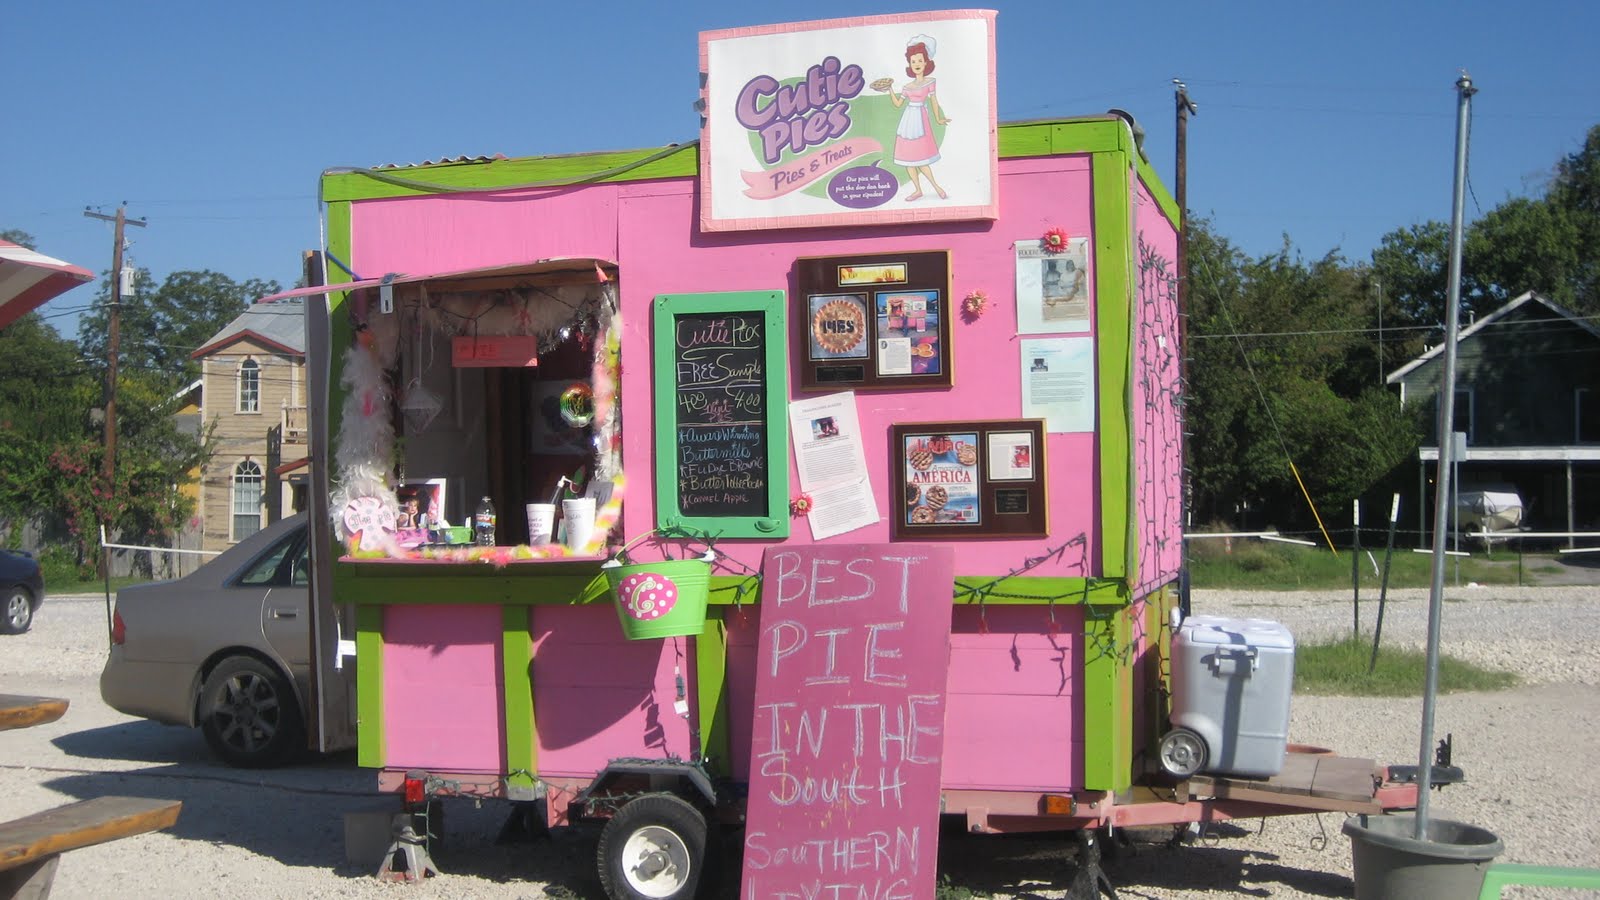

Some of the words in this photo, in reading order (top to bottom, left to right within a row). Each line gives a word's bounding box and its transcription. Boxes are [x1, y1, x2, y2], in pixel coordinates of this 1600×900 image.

[735, 56, 865, 130] Cutie
[759, 101, 851, 164] Pies
[770, 168, 805, 191] Pies
[810, 159, 820, 172] &
[821, 146, 852, 165] Treats
[836, 185, 845, 193] put
[677, 320, 731, 348] Cutie
[677, 362, 719, 382] FREE
[913, 470, 971, 483] AMERICA
[773, 552, 928, 614] BEST
[763, 620, 907, 687] PIE
[758, 702, 827, 758] IN
[834, 694, 940, 764] THE
